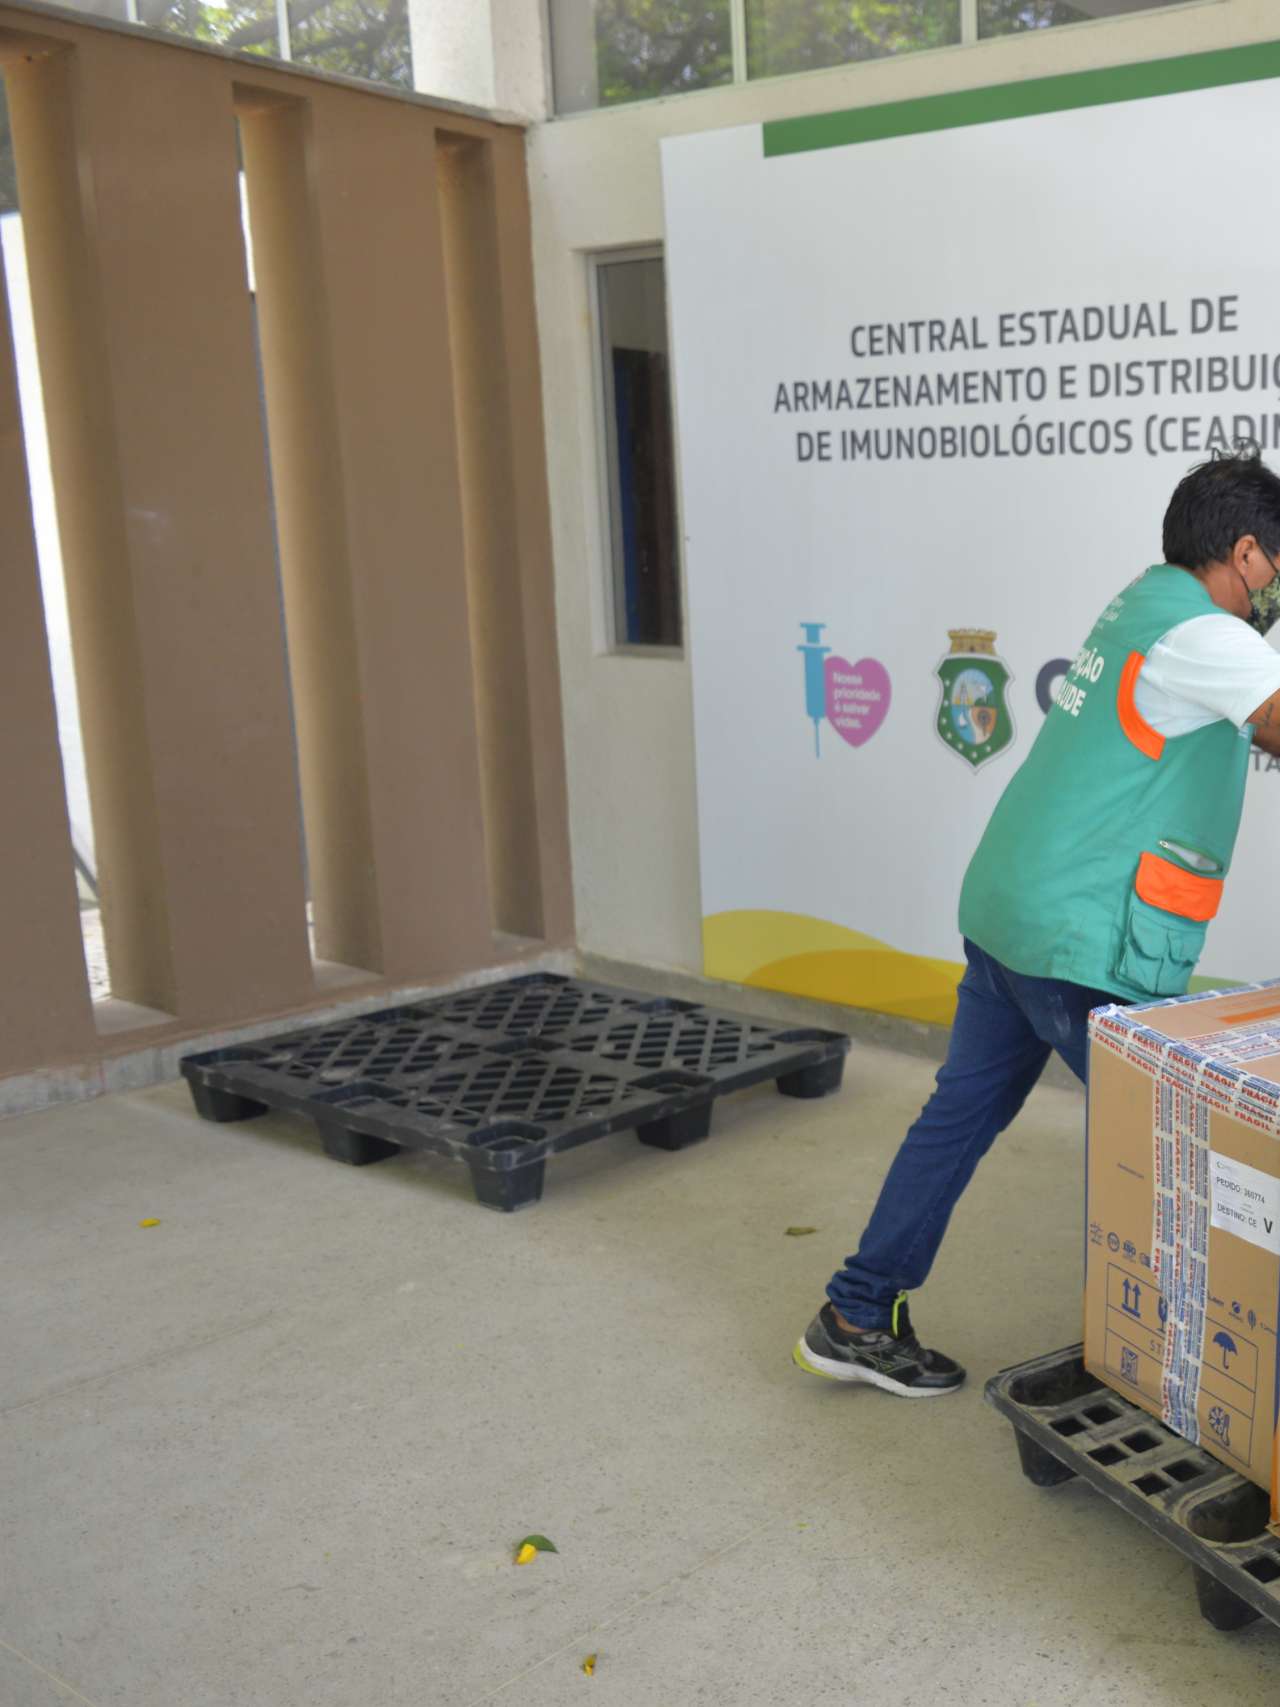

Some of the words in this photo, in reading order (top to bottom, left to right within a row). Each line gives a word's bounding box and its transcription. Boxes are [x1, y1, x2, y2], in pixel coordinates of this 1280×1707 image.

[850, 316, 988, 358] CENTRAL
[998, 301, 1177, 348] ESTADUAL
[1190, 295, 1239, 334] DE
[774, 367, 1047, 414] ARMAZENAMENTO
[1058, 365, 1077, 399] E
[797, 432, 833, 463] DE
[840, 415, 1133, 461] IMUNOBIOLÓGICOS
[1263, 1217, 1273, 1235] V
